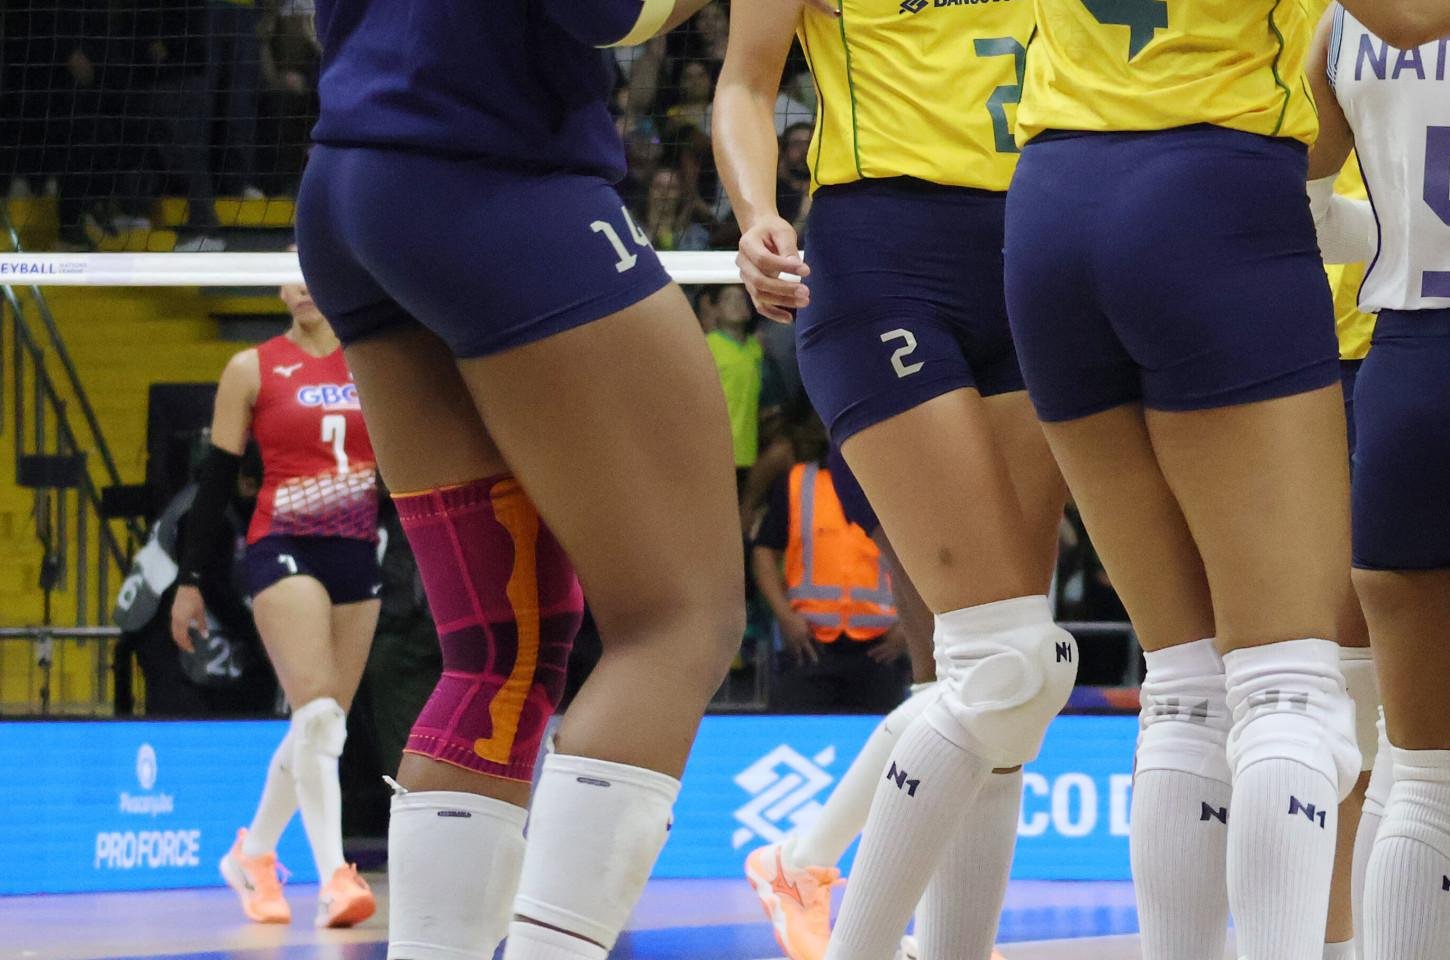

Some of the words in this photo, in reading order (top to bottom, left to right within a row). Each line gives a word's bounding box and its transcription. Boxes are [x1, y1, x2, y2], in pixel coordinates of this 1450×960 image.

[880, 328, 924, 378] 2
[321, 414, 349, 476] 7
[887, 761, 921, 798] N1
[1288, 795, 1326, 829] N1
